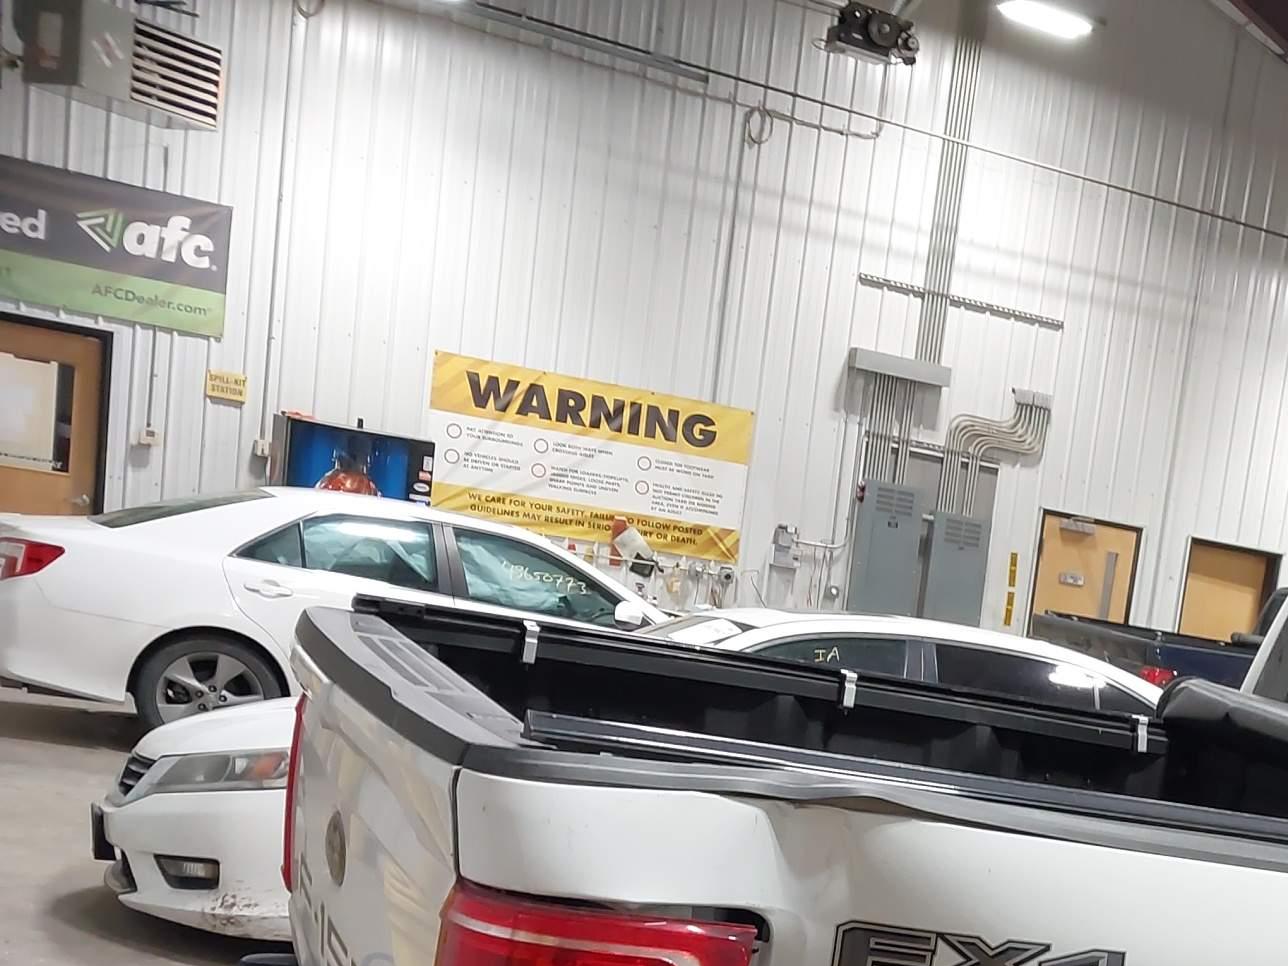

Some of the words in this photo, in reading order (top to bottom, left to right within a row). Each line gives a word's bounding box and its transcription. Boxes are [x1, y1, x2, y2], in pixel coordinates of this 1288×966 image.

[91, 283, 208, 317] AFCDealer.com
[465, 370, 718, 448] WARNING
[468, 492, 481, 501] WE
[484, 494, 506, 505] CARE
[509, 498, 526, 508] FOR
[529, 501, 553, 513] YOUR
[636, 518, 671, 531] FOLLOW
[673, 524, 703, 536] POSTED
[470, 504, 520, 518] GUIDELINES
[522, 511, 542, 521] MAY
[544, 515, 574, 526] RESULT
[575, 519, 585, 527] IN
[587, 521, 611, 532] SERIO
[656, 532, 668, 541] OR
[814, 646, 840, 663] IA
